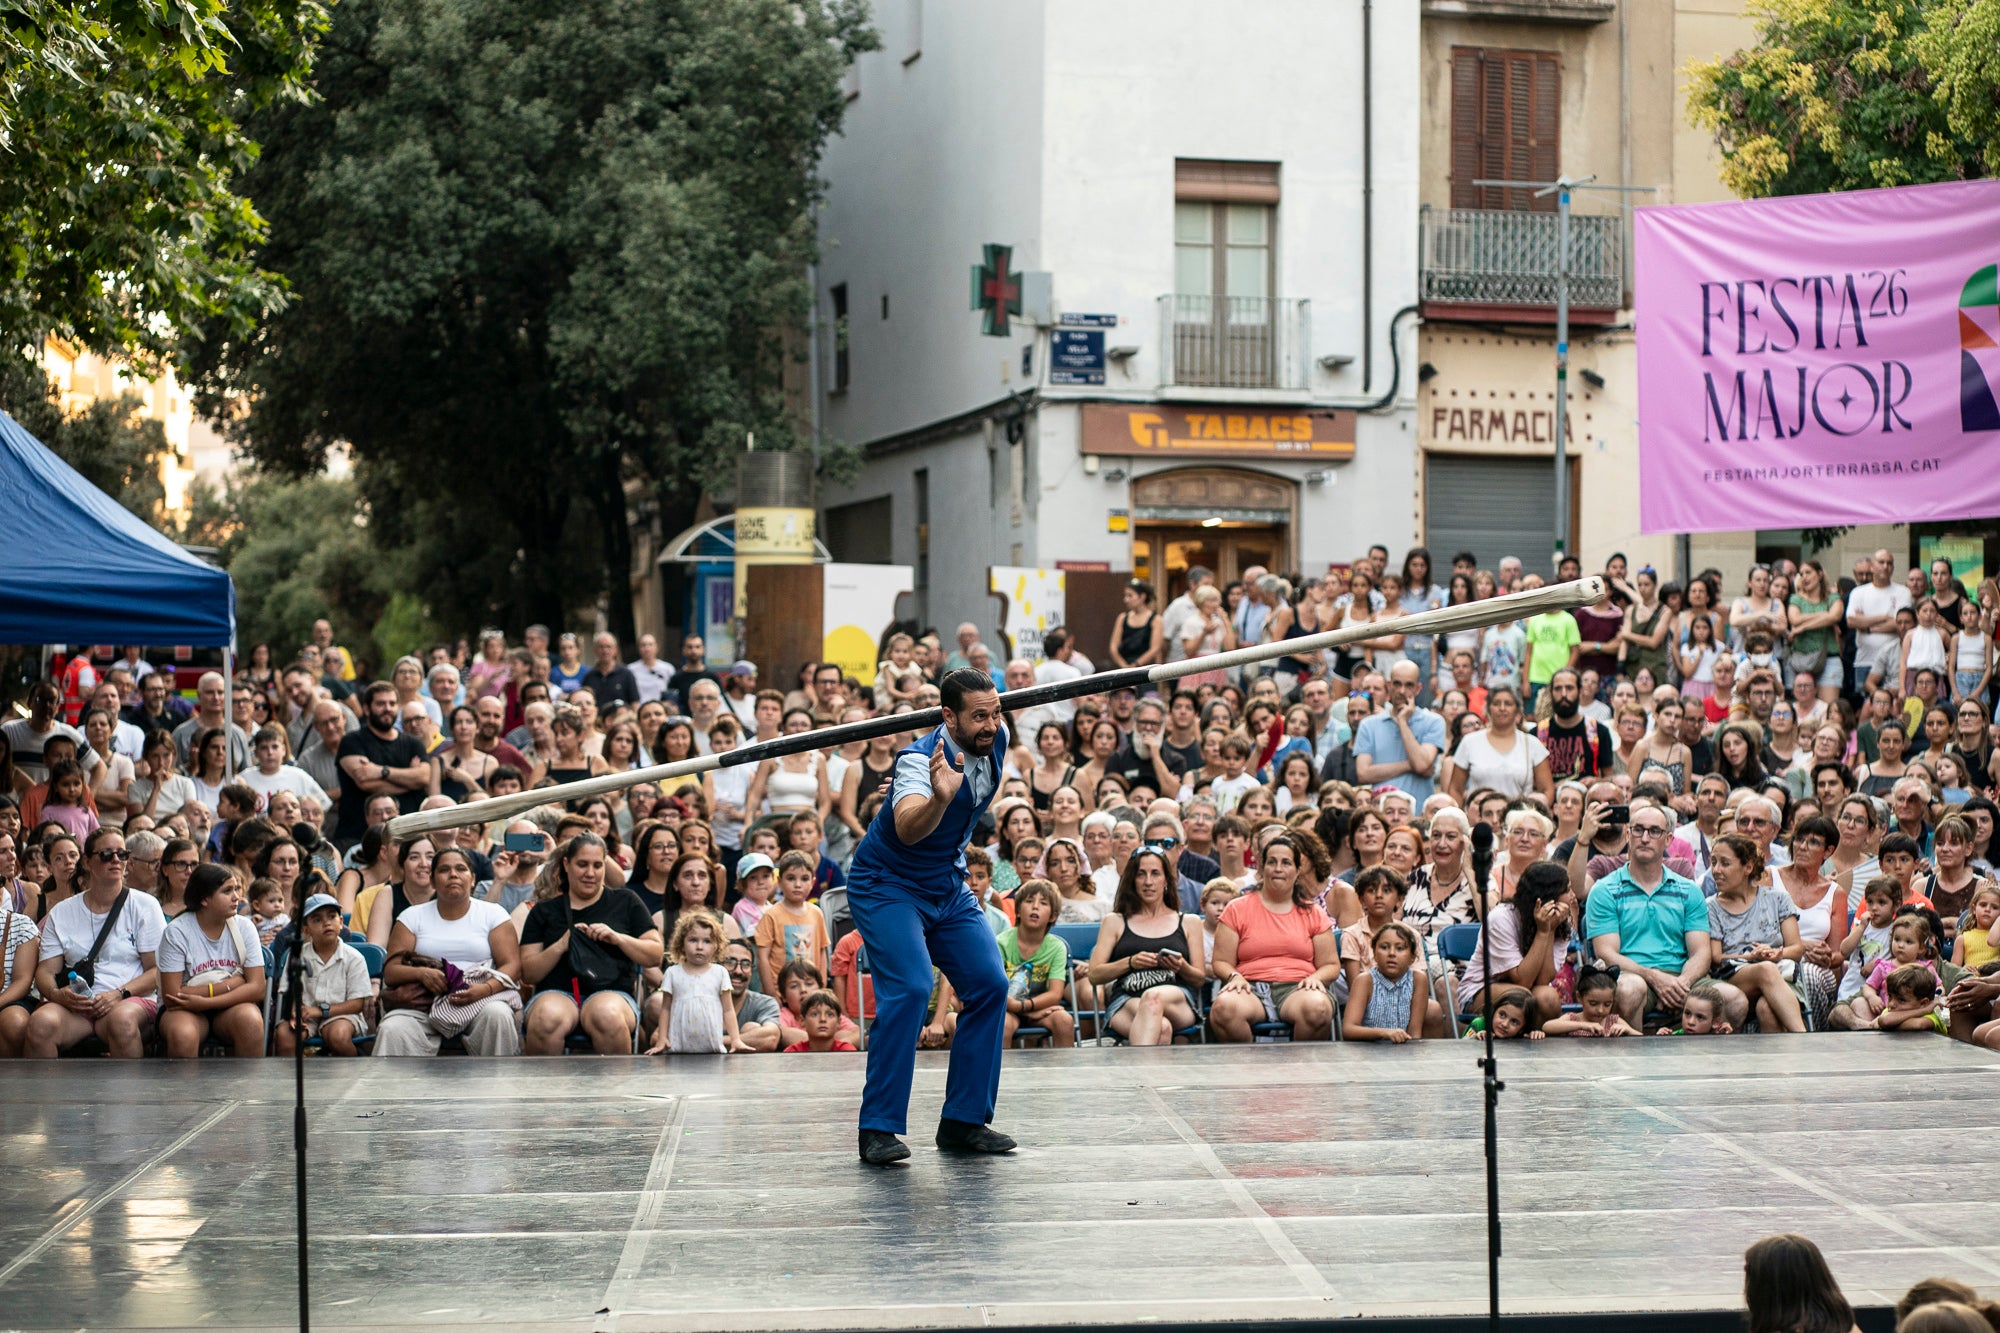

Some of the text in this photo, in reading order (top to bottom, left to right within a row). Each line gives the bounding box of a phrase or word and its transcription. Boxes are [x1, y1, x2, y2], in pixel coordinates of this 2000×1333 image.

[1703, 360, 1913, 443] MAJOR
[1185, 414, 1313, 440] TABACS
[1703, 458, 1942, 482] FESTAMAJORTERRASSA.CAT
